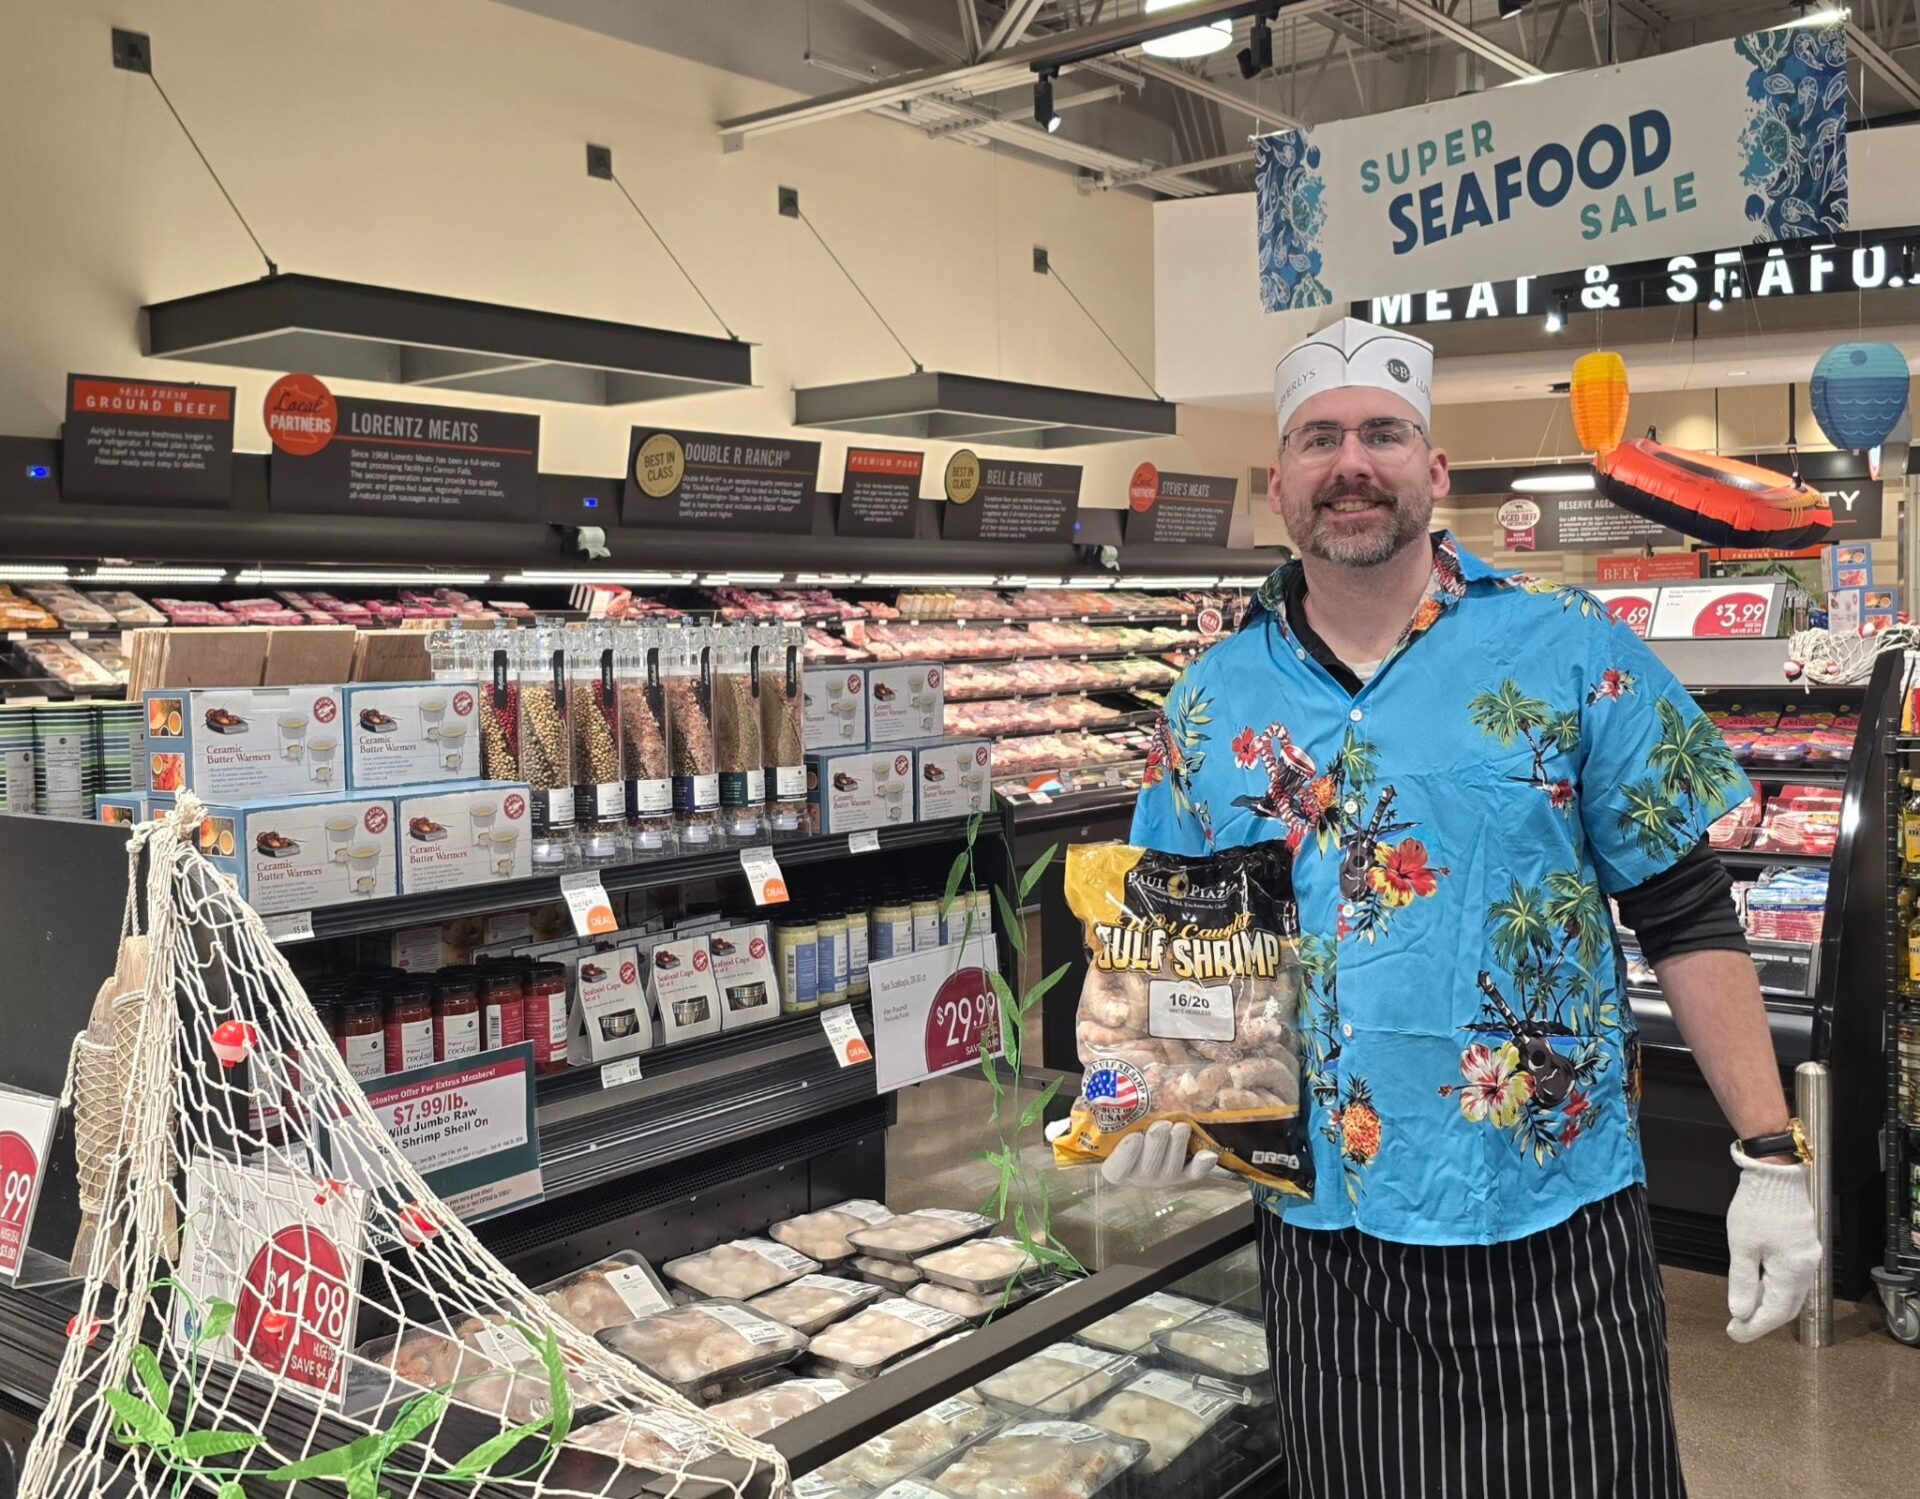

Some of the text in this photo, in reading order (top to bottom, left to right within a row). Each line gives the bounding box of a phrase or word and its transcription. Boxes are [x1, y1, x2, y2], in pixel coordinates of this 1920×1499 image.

[1361, 119, 1495, 194] SUPER
[1388, 109, 1672, 255] SEAFOOD
[1580, 171, 1698, 241] SALE
[1372, 275, 1536, 325] MEAT
[1581, 265, 1620, 308] &
[86, 395, 217, 415] GROUND BEEF
[273, 391, 325, 413] Local
[270, 414, 331, 433] PARTNERS
[351, 411, 479, 443] LORENTZ MEATS
[644, 451, 675, 468] BEST IN
[685, 443, 730, 464] DOUBLE
[734, 447, 741, 464] R
[852, 456, 918, 468] PREMIUM PORK
[647, 465, 674, 483] CLASS
[952, 466, 974, 478] BEST IN
[987, 469, 1043, 488] BELL & EVANS
[953, 478, 971, 490] CLASS
[1161, 481, 1210, 497] STEVE'S MEATS
[1558, 500, 1592, 510] RESERVE
[1604, 566, 1641, 580] BEEF
[1716, 603, 1765, 627] $3.99
[360, 734, 391, 744] Ceramic
[360, 743, 416, 753] Butter Warmers
[206, 744, 242, 754] Ceramic
[207, 752, 271, 764] Butter Warmers
[409, 843, 442, 854] Ceramic
[410, 851, 467, 864] Butter Warmers
[256, 860, 293, 871] Ceramic
[257, 868, 322, 882] Butter Warmers
[1128, 871, 1166, 890] PAUL
[1181, 912, 1251, 940] Caught
[1172, 929, 1280, 979] SHRIMP
[657, 971, 678, 981] Seafood
[582, 985, 605, 995] Seafood
[1169, 993, 1210, 1009] 16/20
[937, 991, 996, 1047] $29.99
[400, 1067, 496, 1098] Offer For Extras Members!
[393, 1092, 469, 1126] $7.99/lb.
[387, 1108, 478, 1139] Wild Jumbo Raw
[402, 1117, 489, 1149] Shrimp Shell On
[291, 1355, 315, 1376] SAVE
